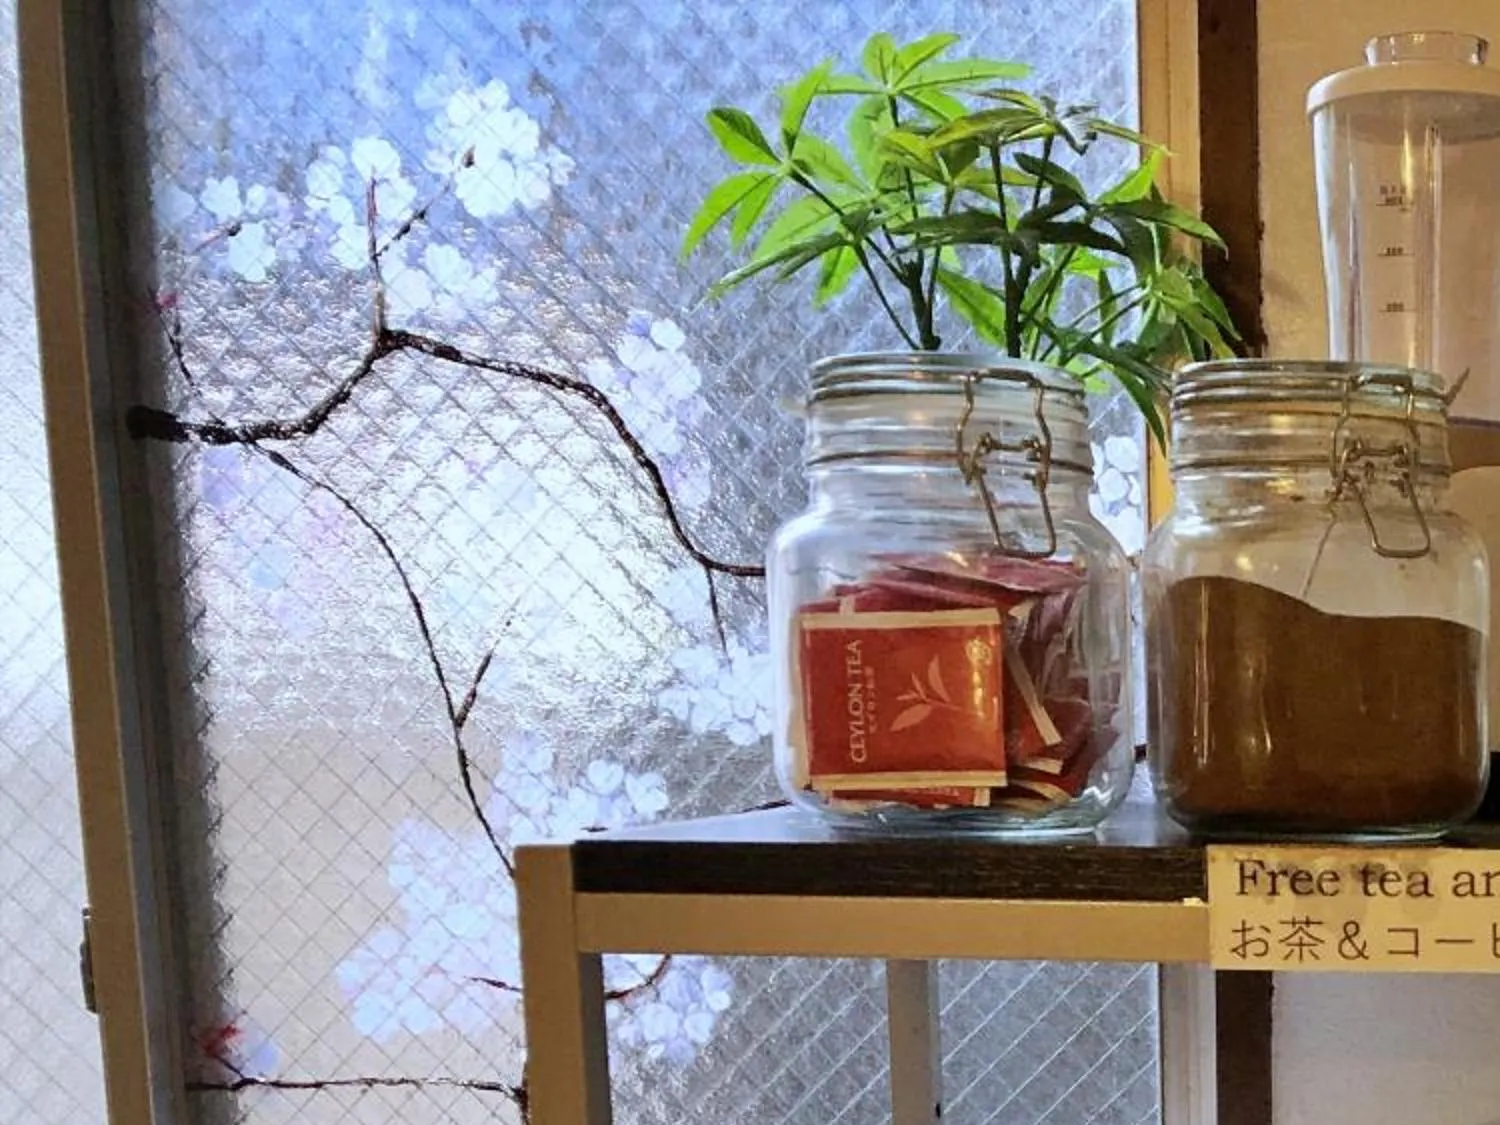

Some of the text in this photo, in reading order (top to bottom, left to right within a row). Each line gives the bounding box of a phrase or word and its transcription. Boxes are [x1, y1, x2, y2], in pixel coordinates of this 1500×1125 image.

[845, 638, 867, 763] CEYLON TEA
[1234, 858, 1342, 898] Free
[1359, 862, 1433, 898] tea
